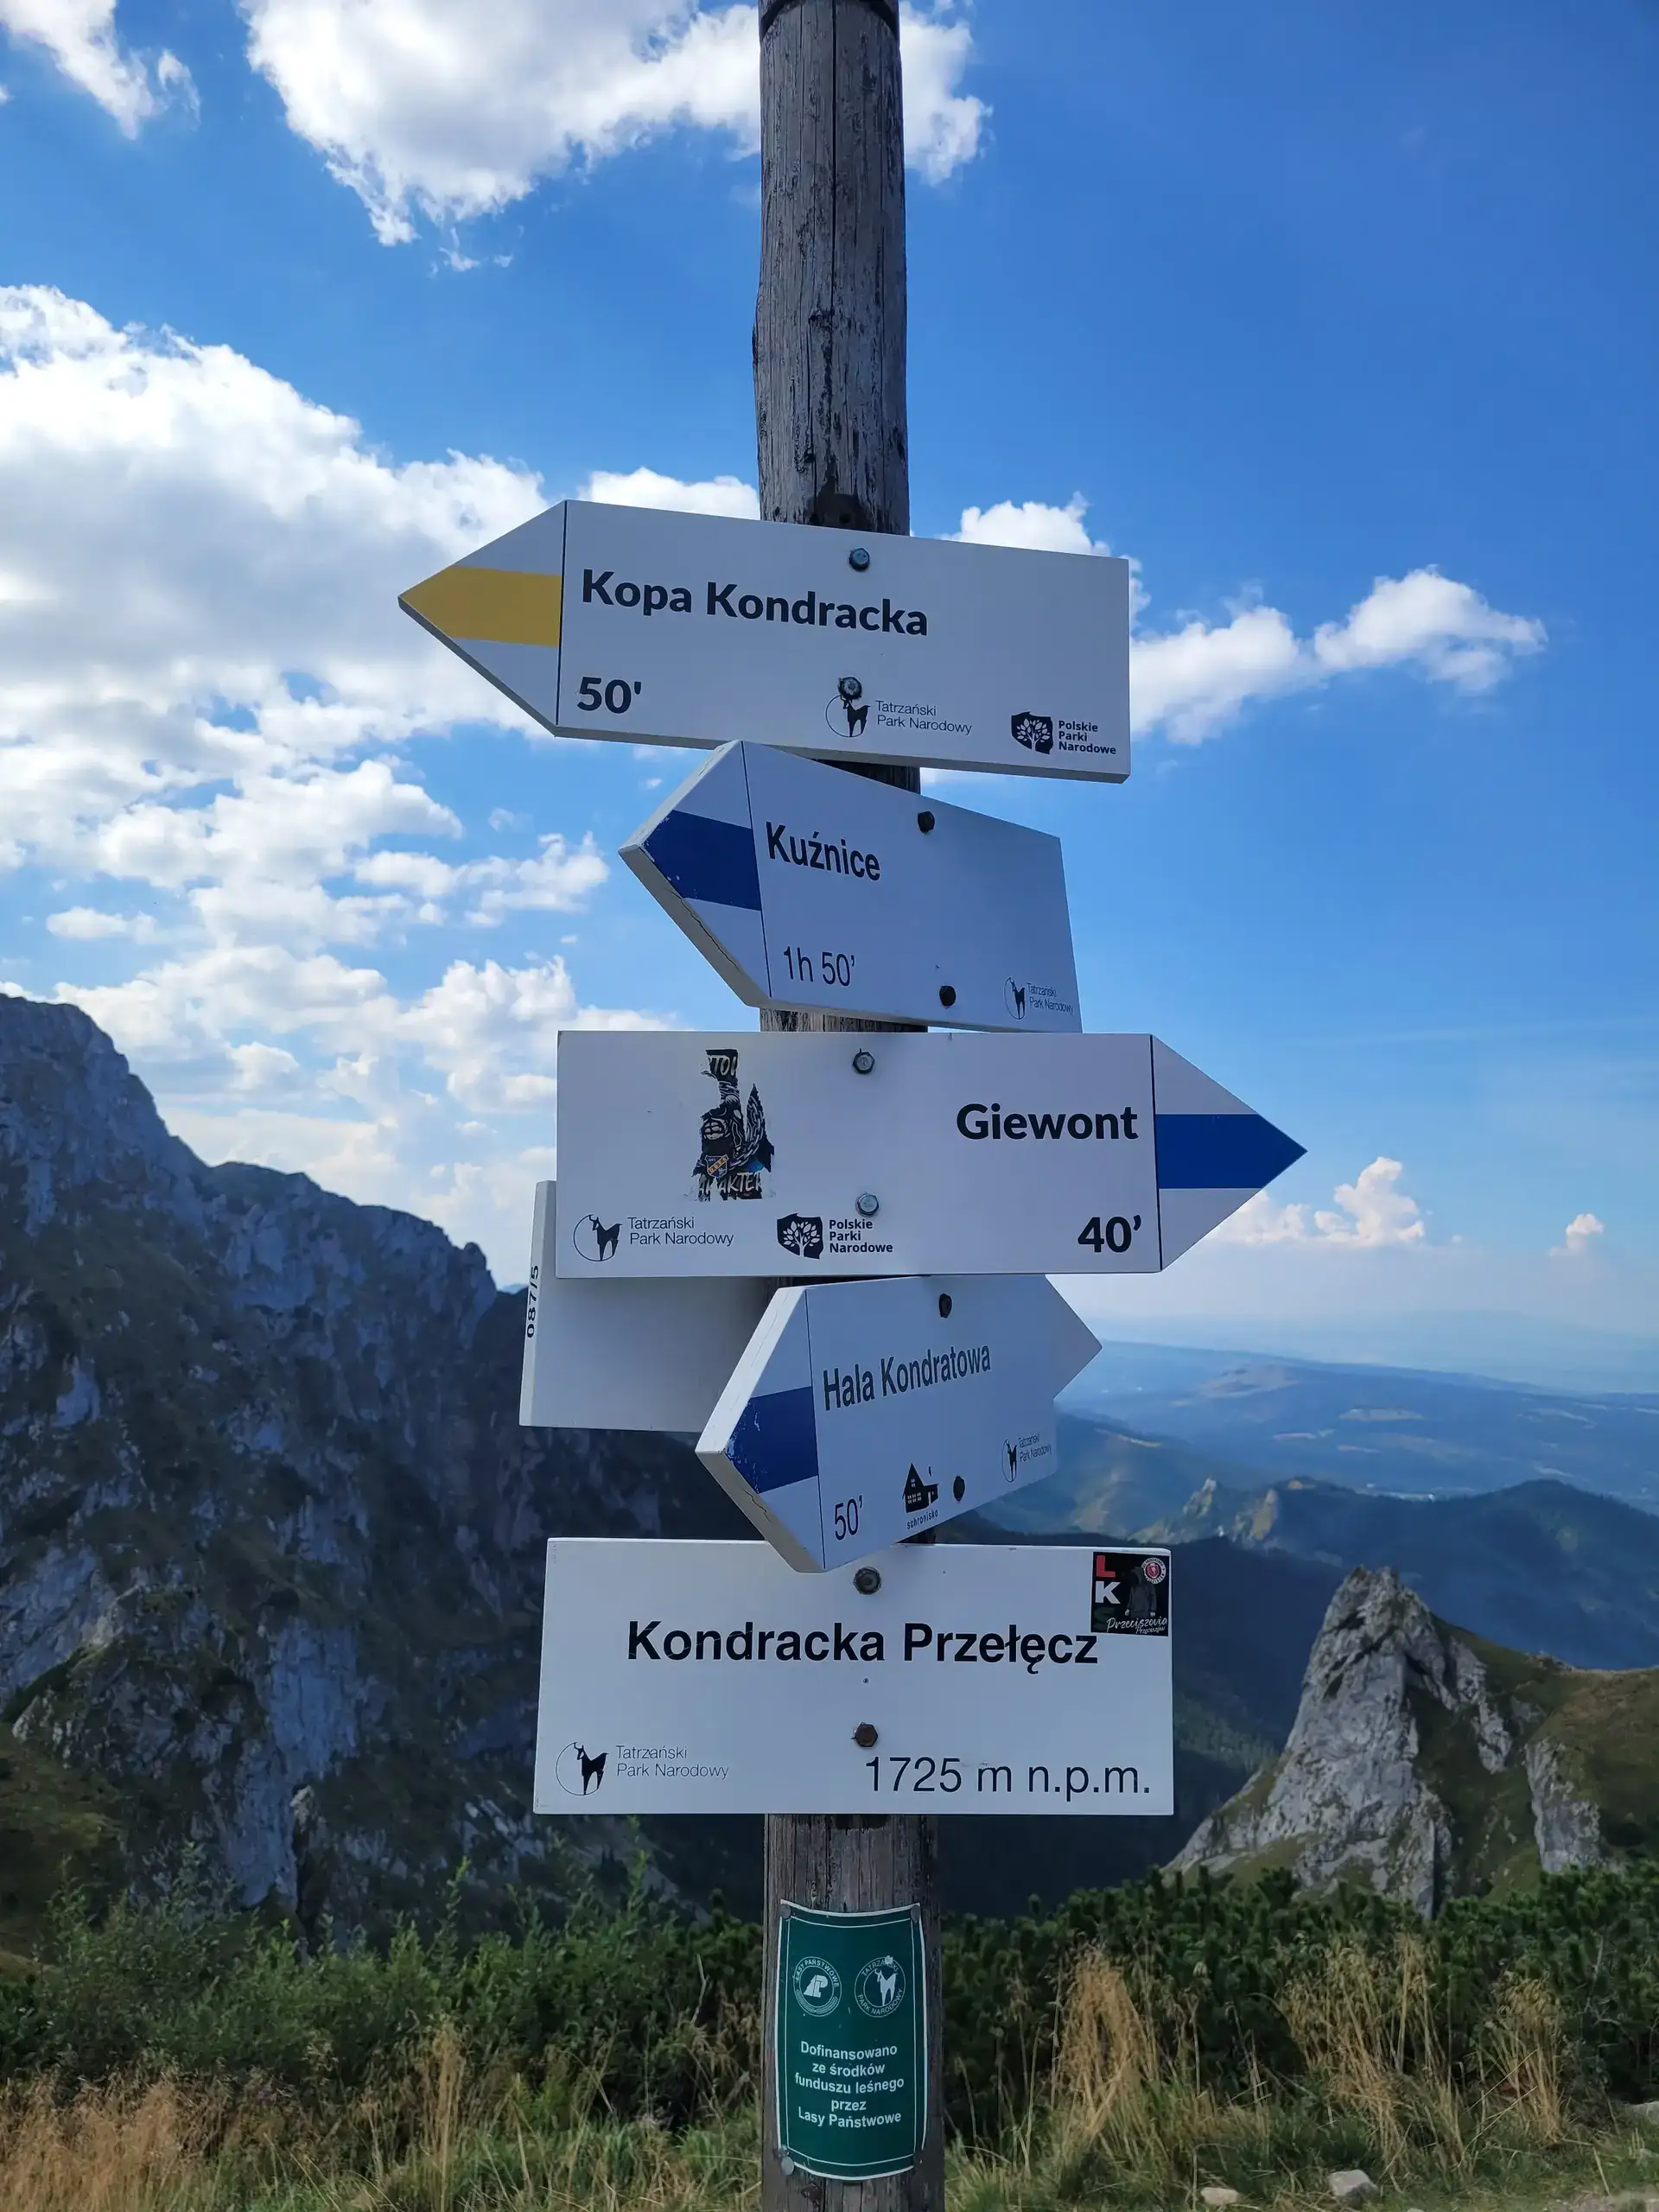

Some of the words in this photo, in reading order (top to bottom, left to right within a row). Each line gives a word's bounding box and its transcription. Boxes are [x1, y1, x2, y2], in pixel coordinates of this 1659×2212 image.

[582, 569, 692, 616] Kopa
[707, 582, 928, 636] Kondracka
[576, 676, 642, 715] 50'
[875, 700, 937, 716] Tatrzański
[877, 715, 906, 728] Park
[910, 717, 972, 735] Narodowy
[1058, 720, 1098, 732] Polskie
[1058, 731, 1088, 741] Parki
[1058, 741, 1116, 754] Narodowe
[766, 821, 880, 880] Kuźnice
[783, 946, 813, 982] 1h
[822, 951, 855, 987] 50'
[1027, 982, 1057, 997] Tatrzański
[1029, 996, 1044, 1009] Park
[1045, 999, 1074, 1015] Narodowy
[957, 1103, 1139, 1140] Giewont
[627, 1217, 695, 1229] Tatrzański
[830, 1218, 874, 1230] Polskie
[630, 1232, 661, 1244] Park
[665, 1232, 734, 1247] Narodowy
[830, 1230, 861, 1241] Parki
[1077, 1214, 1141, 1253] 40'
[830, 1243, 893, 1253] Narodowe
[526, 1265, 539, 1338] 087/5
[823, 1363, 875, 1411] Hala
[880, 1344, 991, 1396] Kondratowa
[835, 1495, 862, 1541] 50'
[906, 1509, 938, 1529] schronisko
[628, 1621, 885, 1661] Kondracka
[904, 1623, 1098, 1675] Przełęcz
[616, 1745, 688, 1759] Tatrzański
[617, 1764, 650, 1777] Park
[655, 1764, 729, 1780] Narodowy
[866, 1757, 963, 1793] 1725
[977, 1765, 1012, 1793] m
[1029, 1765, 1151, 1802] n.p.m.
[795, 1963, 805, 1984] LASY
[804, 1958, 840, 1988] PAŃSTWOWE
[861, 1959, 899, 1976] TATRZASKI
[857, 1993, 870, 2012] PARK
[871, 1988, 903, 2015] NARODOWY
[800, 2040, 899, 2061] Dofinansowano
[812, 2063, 826, 2074] ze
[830, 2063, 886, 2077] środków
[795, 2072, 851, 2094] funduszu
[855, 2078, 905, 2093] leśnego
[831, 2100, 868, 2112] przez
[798, 2106, 825, 2126] Lasy
[830, 2113, 901, 2128] Państwowe
